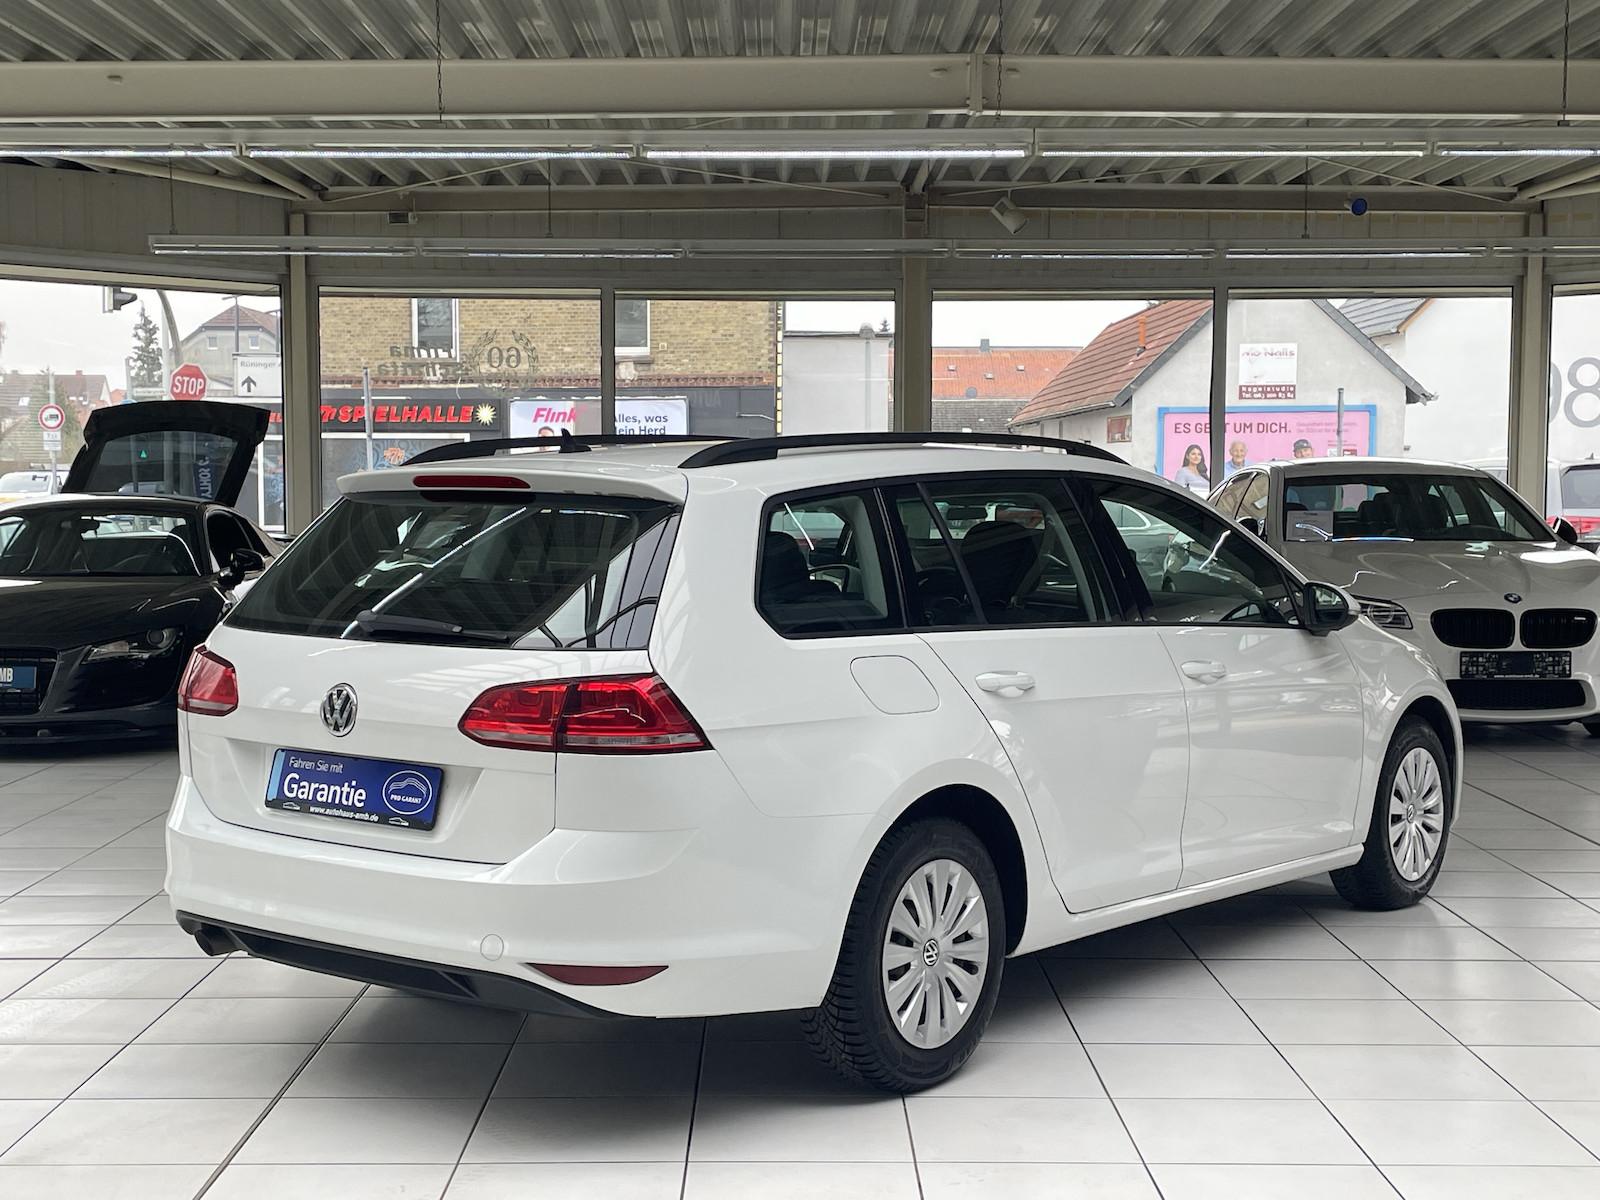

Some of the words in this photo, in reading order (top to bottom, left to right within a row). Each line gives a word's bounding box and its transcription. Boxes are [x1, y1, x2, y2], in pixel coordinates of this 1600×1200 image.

[172, 376, 204, 396] STOP
[338, 404, 474, 423] SPELHALLE
[644, 415, 668, 423] was
[1174, 422, 1191, 434] ES
[1194, 422, 1230, 434] GET
[1233, 422, 1251, 434] UM
[1257, 422, 1292, 434] DICH.
[289, 756, 315, 770] Fahren
[316, 759, 329, 772] Sie
[330, 761, 344, 774] mit
[283, 772, 367, 808] Garantie
[309, 805, 379, 822] www.autohaus-amb.de
